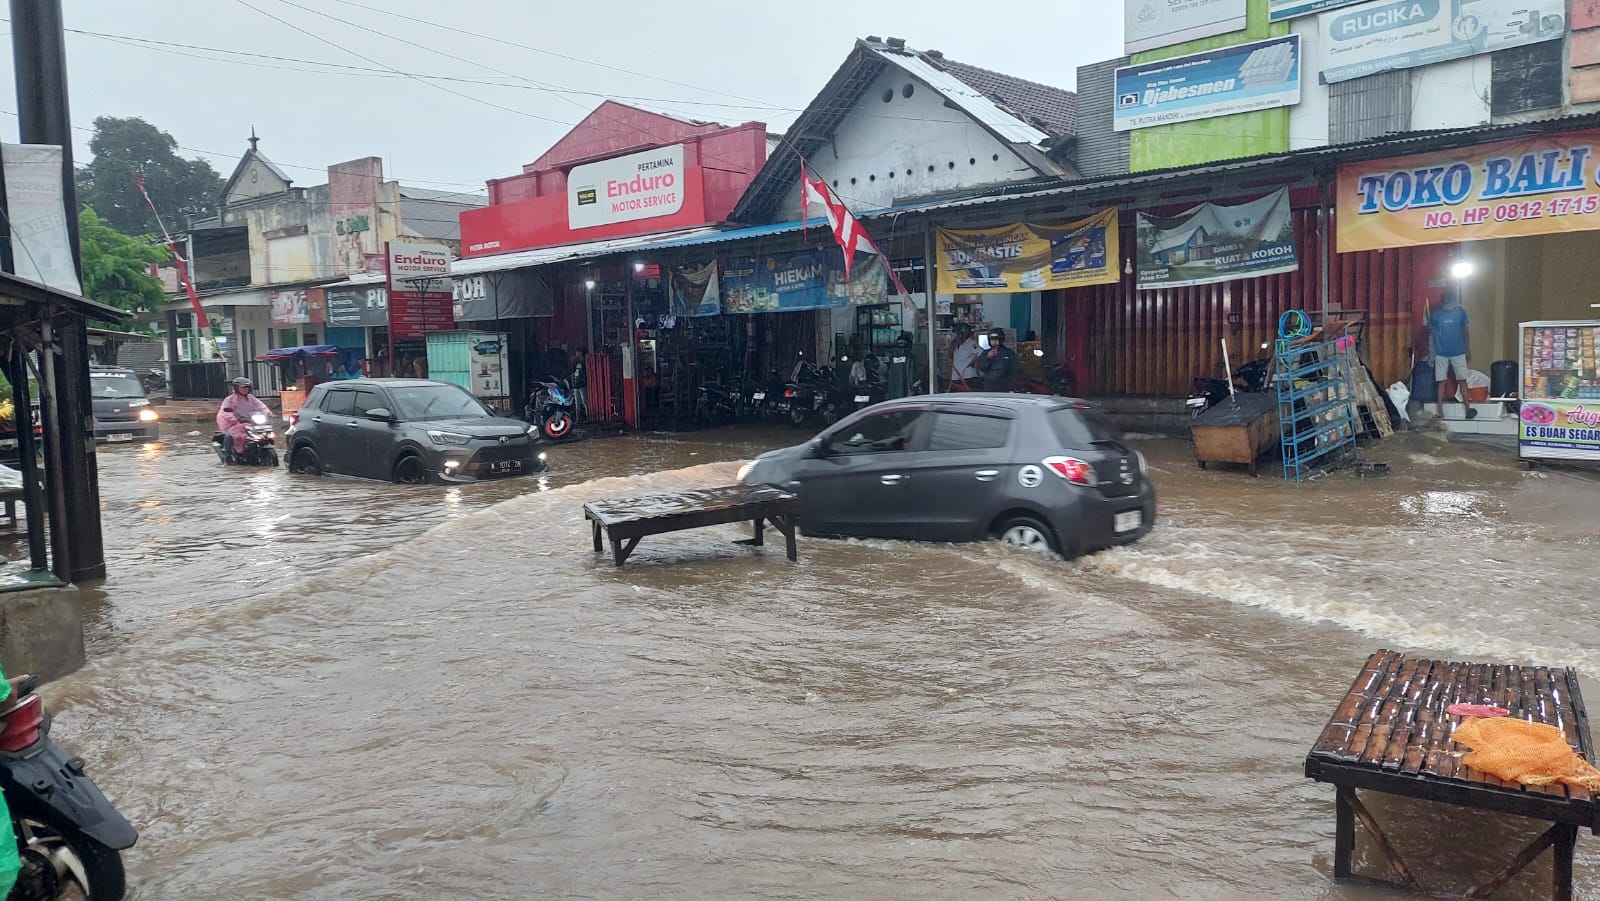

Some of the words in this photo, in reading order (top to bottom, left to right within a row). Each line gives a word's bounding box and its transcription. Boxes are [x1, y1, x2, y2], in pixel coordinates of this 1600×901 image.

[1342, 3, 1425, 35] RUCIKA
[1142, 78, 1236, 107] Djabesmen
[637, 157, 674, 173] PERTAMINA
[606, 172, 675, 198] Enduro
[1357, 163, 1472, 214] TOKO
[1480, 147, 1589, 200] BALI
[611, 197, 641, 213] MOTOR
[643, 193, 676, 208] SERVICE
[1424, 211, 1457, 229] NO.
[1462, 206, 1489, 225] HP
[1495, 202, 1542, 222] 0812
[1549, 195, 1599, 215] 1715
[393, 254, 447, 266] Enduro
[1214, 254, 1241, 265] KUAT
[1242, 252, 1250, 260] &
[1252, 245, 1293, 259] KOKOH
[366, 287, 386, 311] PU
[452, 276, 485, 301] TOR
[1525, 426, 1537, 437] ES
[1540, 427, 1566, 439] BUAH
[1568, 429, 1600, 441] SEGAR
